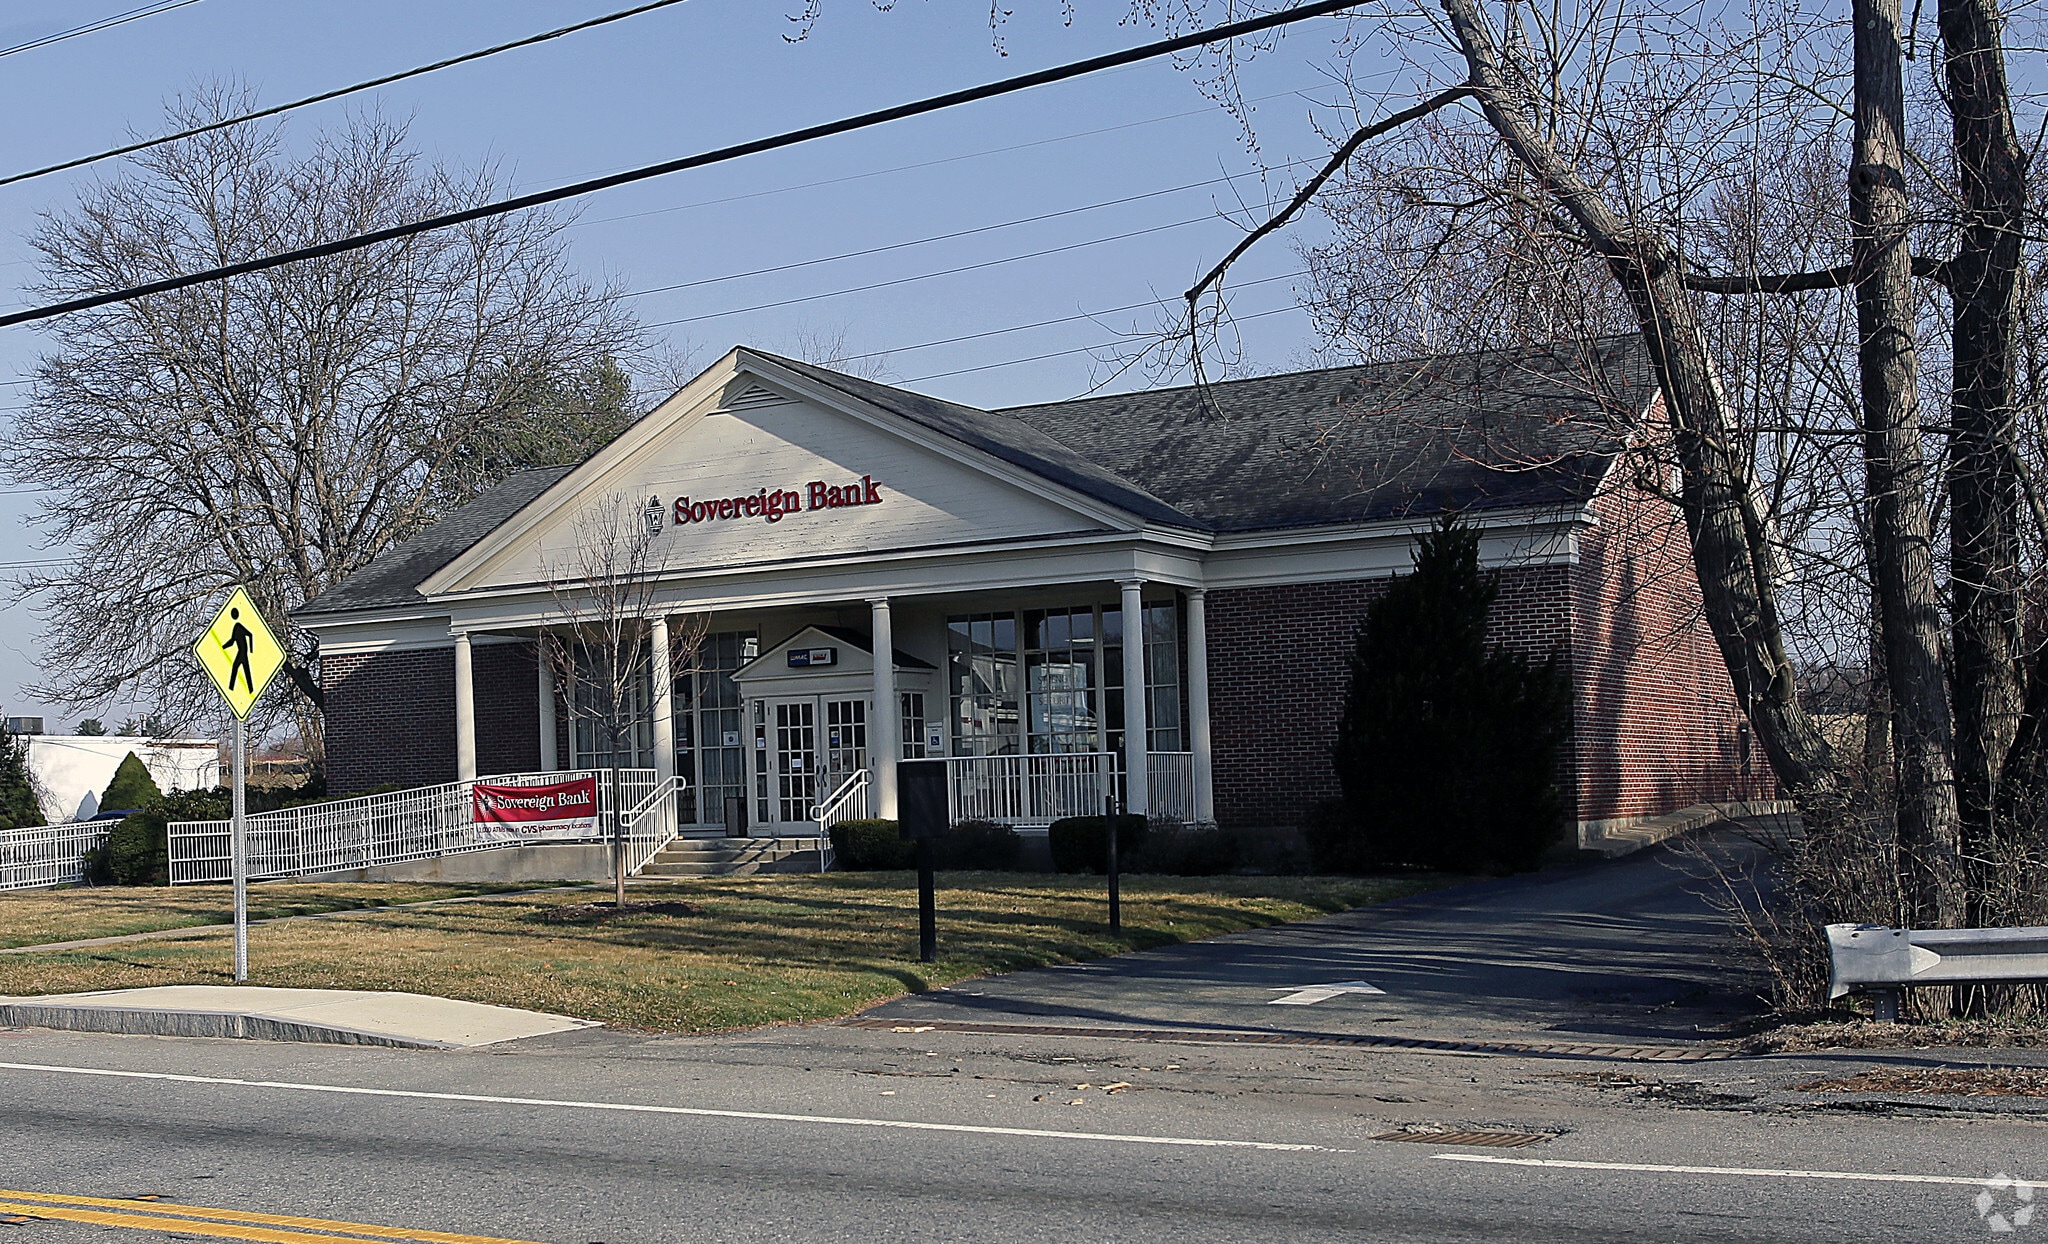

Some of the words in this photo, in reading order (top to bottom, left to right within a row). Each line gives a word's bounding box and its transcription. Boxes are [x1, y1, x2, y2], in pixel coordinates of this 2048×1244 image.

[674, 488, 802, 524] Sovereign
[806, 474, 883, 511] Bank
[496, 794, 556, 812] Sovereign
[557, 789, 591, 807] Bank
